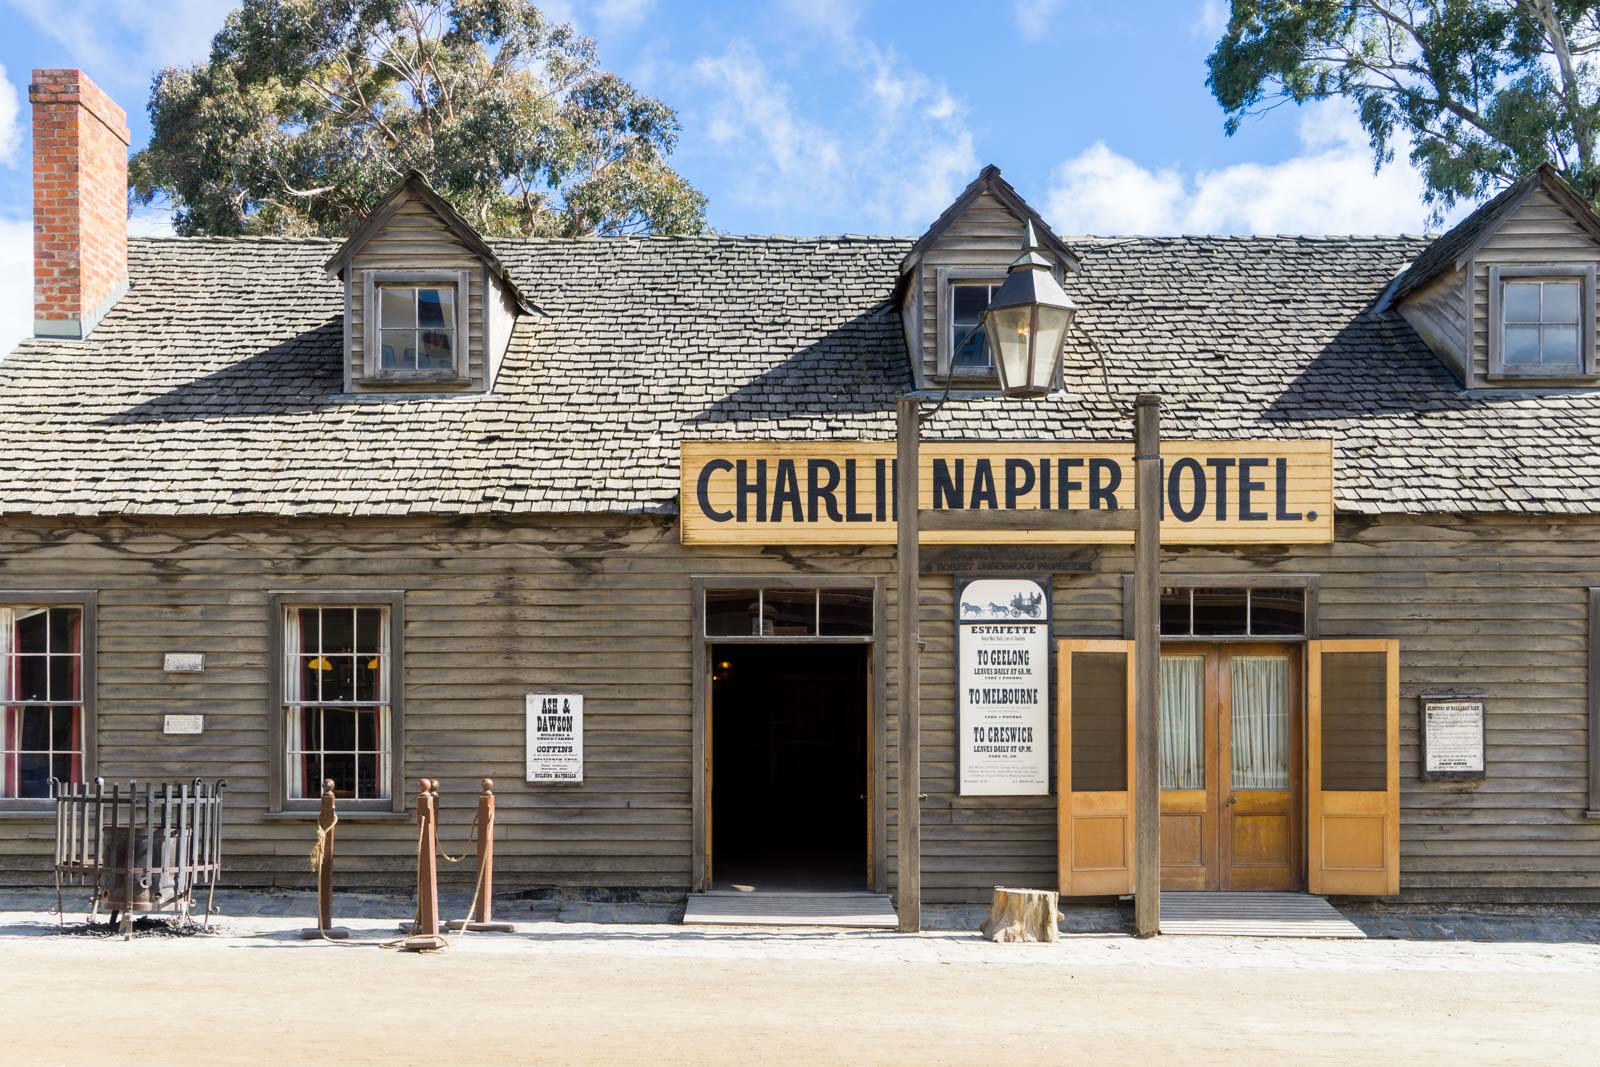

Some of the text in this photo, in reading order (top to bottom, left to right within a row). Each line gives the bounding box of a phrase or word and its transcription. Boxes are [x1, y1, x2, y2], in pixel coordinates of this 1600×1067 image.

[696, 457, 1318, 523] CHARLI NAPIER OTEL.
[937, 561, 975, 572] ROBERT
[977, 560, 1034, 570] UNDERWOOD
[971, 626, 1036, 634] ESTAFETTE
[976, 650, 1030, 666] TO GEELONG
[969, 688, 1038, 704] TO MELBOURNE
[542, 698, 571, 714] ASH &
[537, 716, 573, 732] DAWSON
[974, 727, 1033, 743] TO CRESWICK
[536, 746, 573, 754] COFFINS
